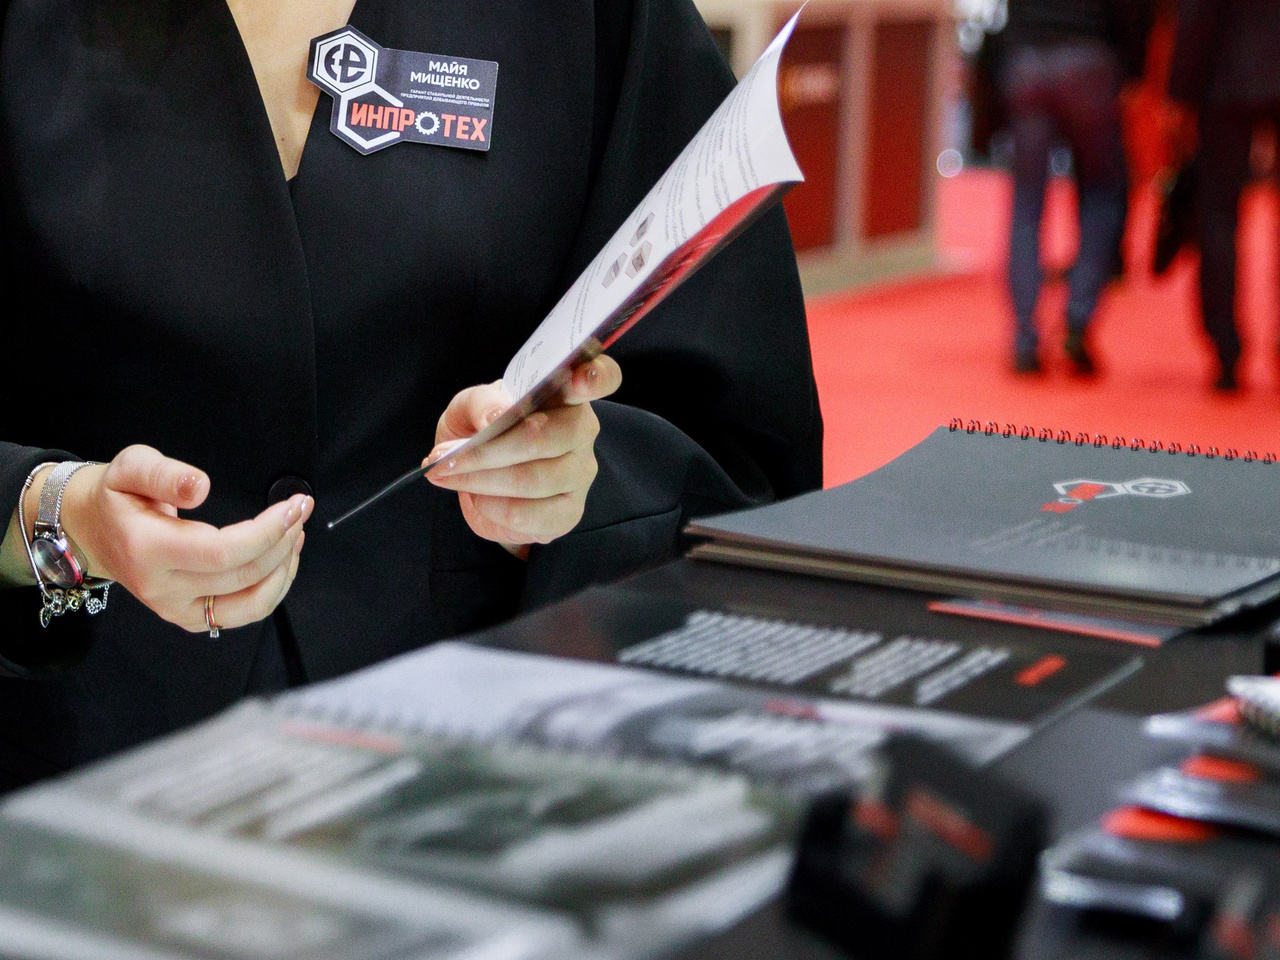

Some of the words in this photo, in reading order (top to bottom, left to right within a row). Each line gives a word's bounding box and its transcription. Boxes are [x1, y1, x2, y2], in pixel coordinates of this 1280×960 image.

[428, 60, 468, 76] МАЙЯ
[409, 71, 480, 90] МИЩЕНКО
[350, 102, 488, 142] ИНПРОТЕХ
